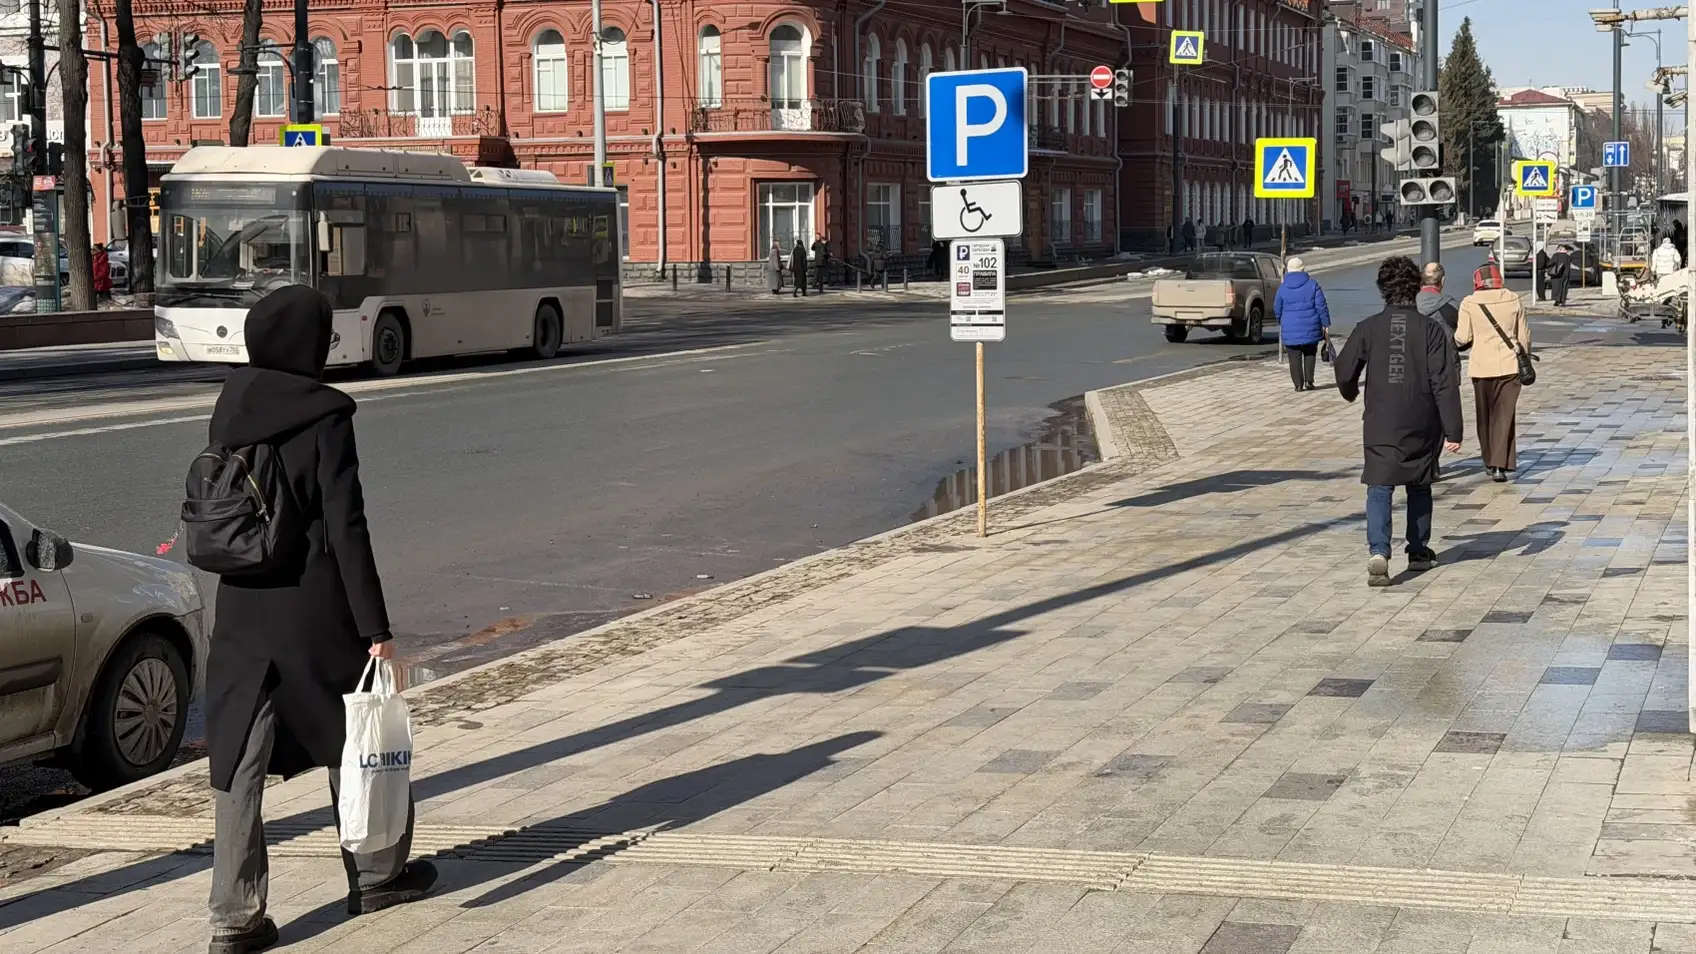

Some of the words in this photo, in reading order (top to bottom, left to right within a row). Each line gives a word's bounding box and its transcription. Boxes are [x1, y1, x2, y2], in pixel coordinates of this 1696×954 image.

[955, 83, 1008, 166] P
[1578, 188, 1591, 206] P
[957, 265, 970, 274] 40
[1389, 313, 1407, 353] NEXT
[1388, 353, 1405, 384] GEN
[359, 753, 378, 769] LC
